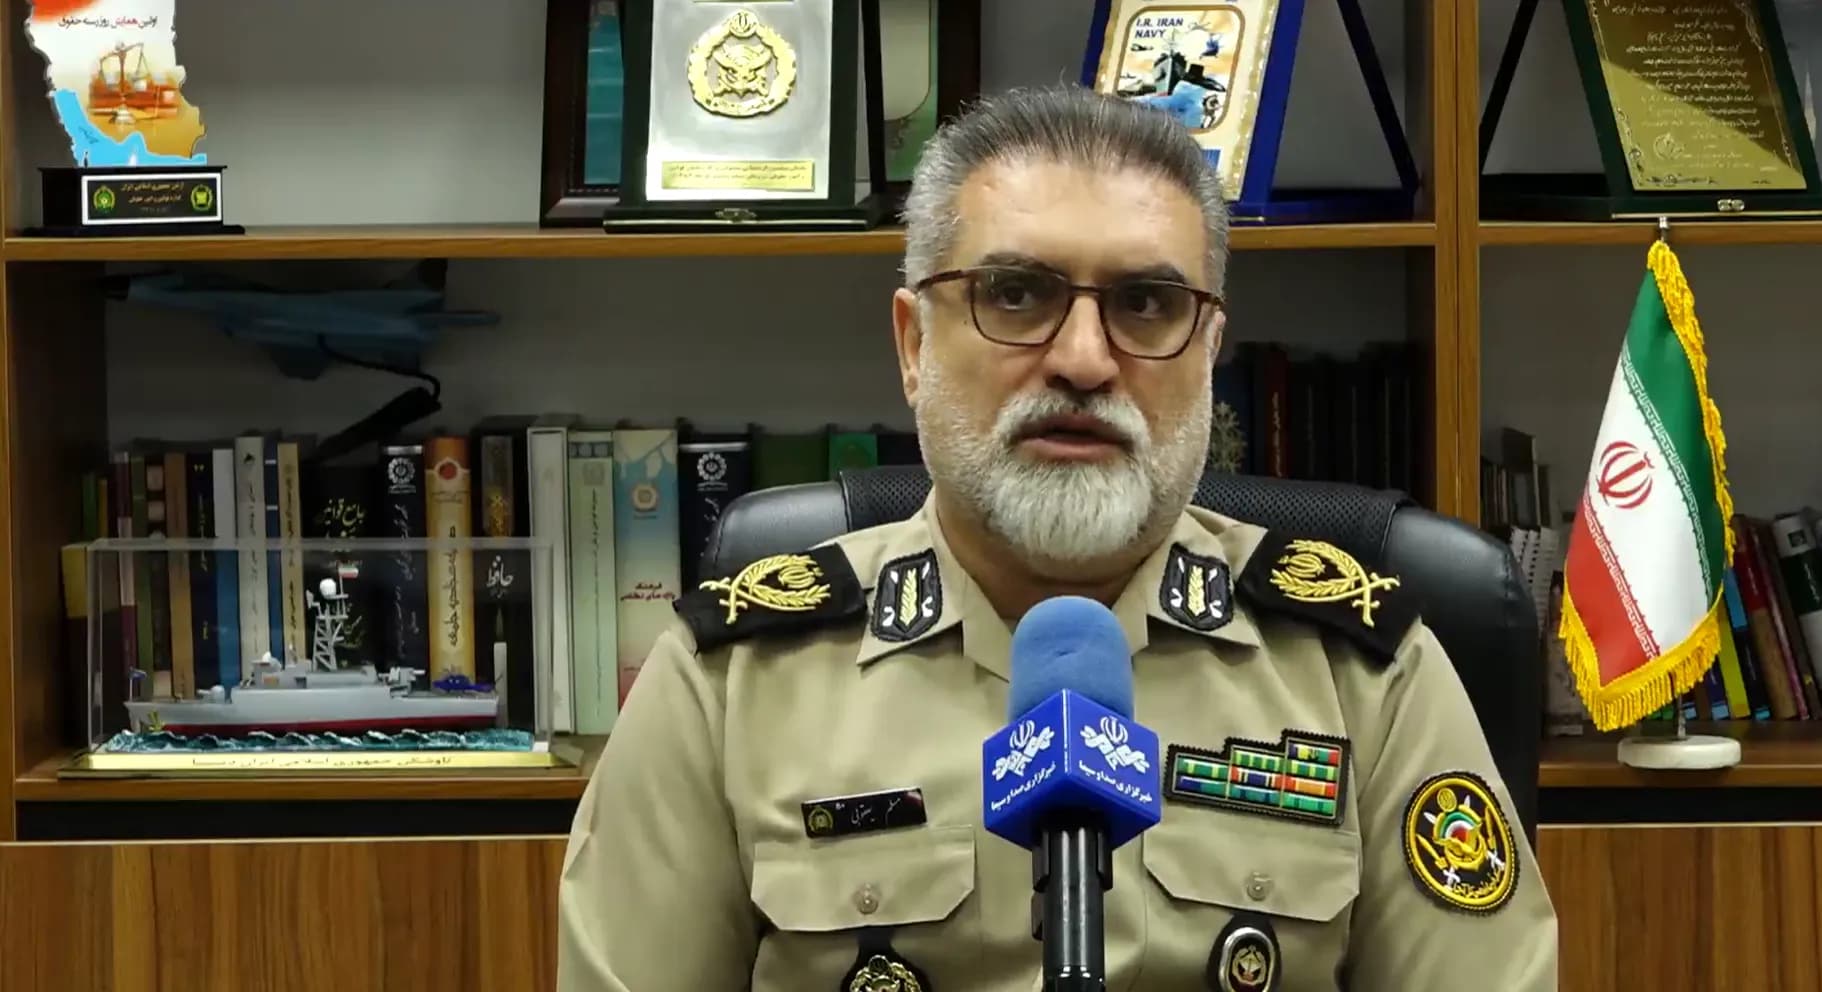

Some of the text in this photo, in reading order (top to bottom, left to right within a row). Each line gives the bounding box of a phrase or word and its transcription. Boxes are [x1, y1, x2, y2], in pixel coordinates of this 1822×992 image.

[1136, 17, 1184, 27] I.R. IRAN
[1135, 29, 1166, 38] NAVY
[486, 554, 513, 588] حافظ
[1024, 760, 1056, 792] خبرگزاری
[1079, 760, 1096, 777] سیما
[1115, 782, 1153, 804] خبرگزاری
[991, 797, 1006, 811] سیما
